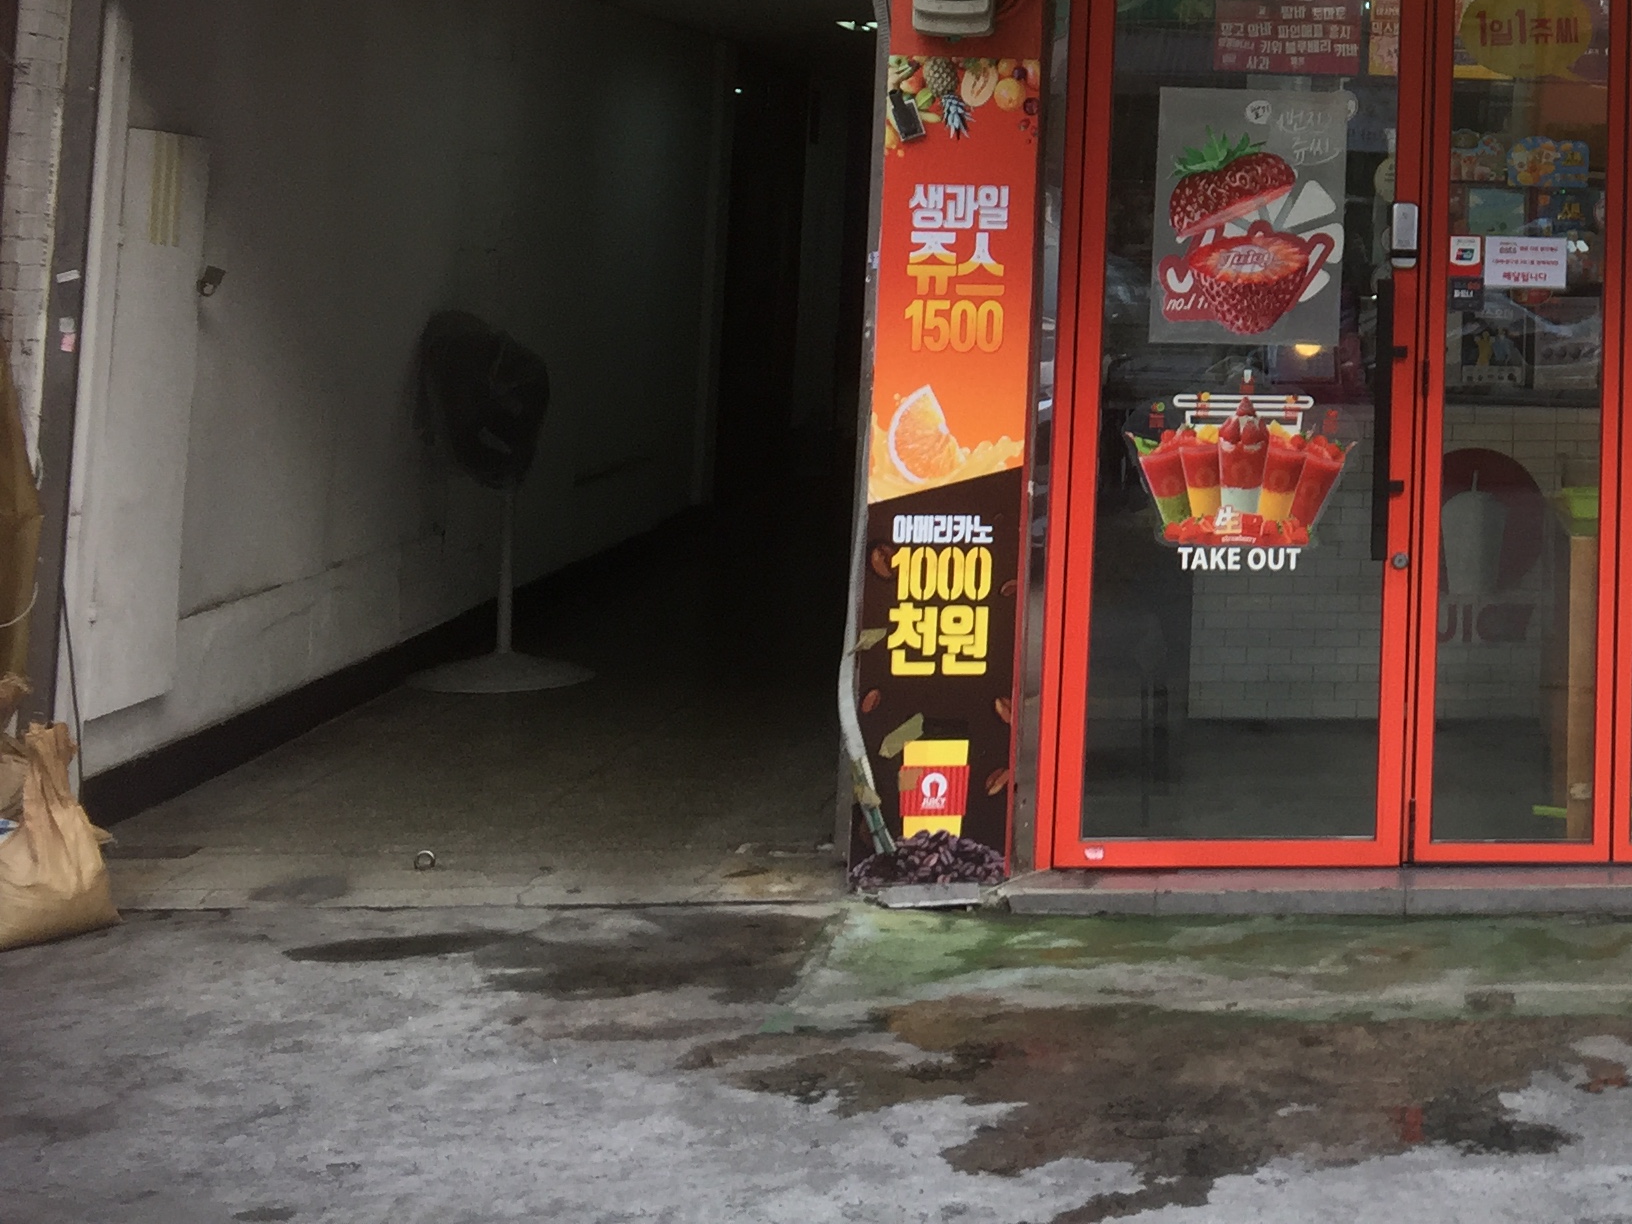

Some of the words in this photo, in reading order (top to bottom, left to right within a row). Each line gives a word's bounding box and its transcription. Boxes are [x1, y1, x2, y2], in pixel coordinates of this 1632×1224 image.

[1475, 9, 1579, 48] 1일1쥬씨
[908, 183, 1010, 231] 생과일
[906, 231, 1005, 296] 쥬스
[905, 300, 1005, 354] 1500
[893, 514, 994, 544] 아메리카노
[891, 546, 993, 602] 1000
[1177, 547, 1241, 571] TAKE
[1247, 547, 1302, 571] OUT
[887, 604, 989, 677] 천원
